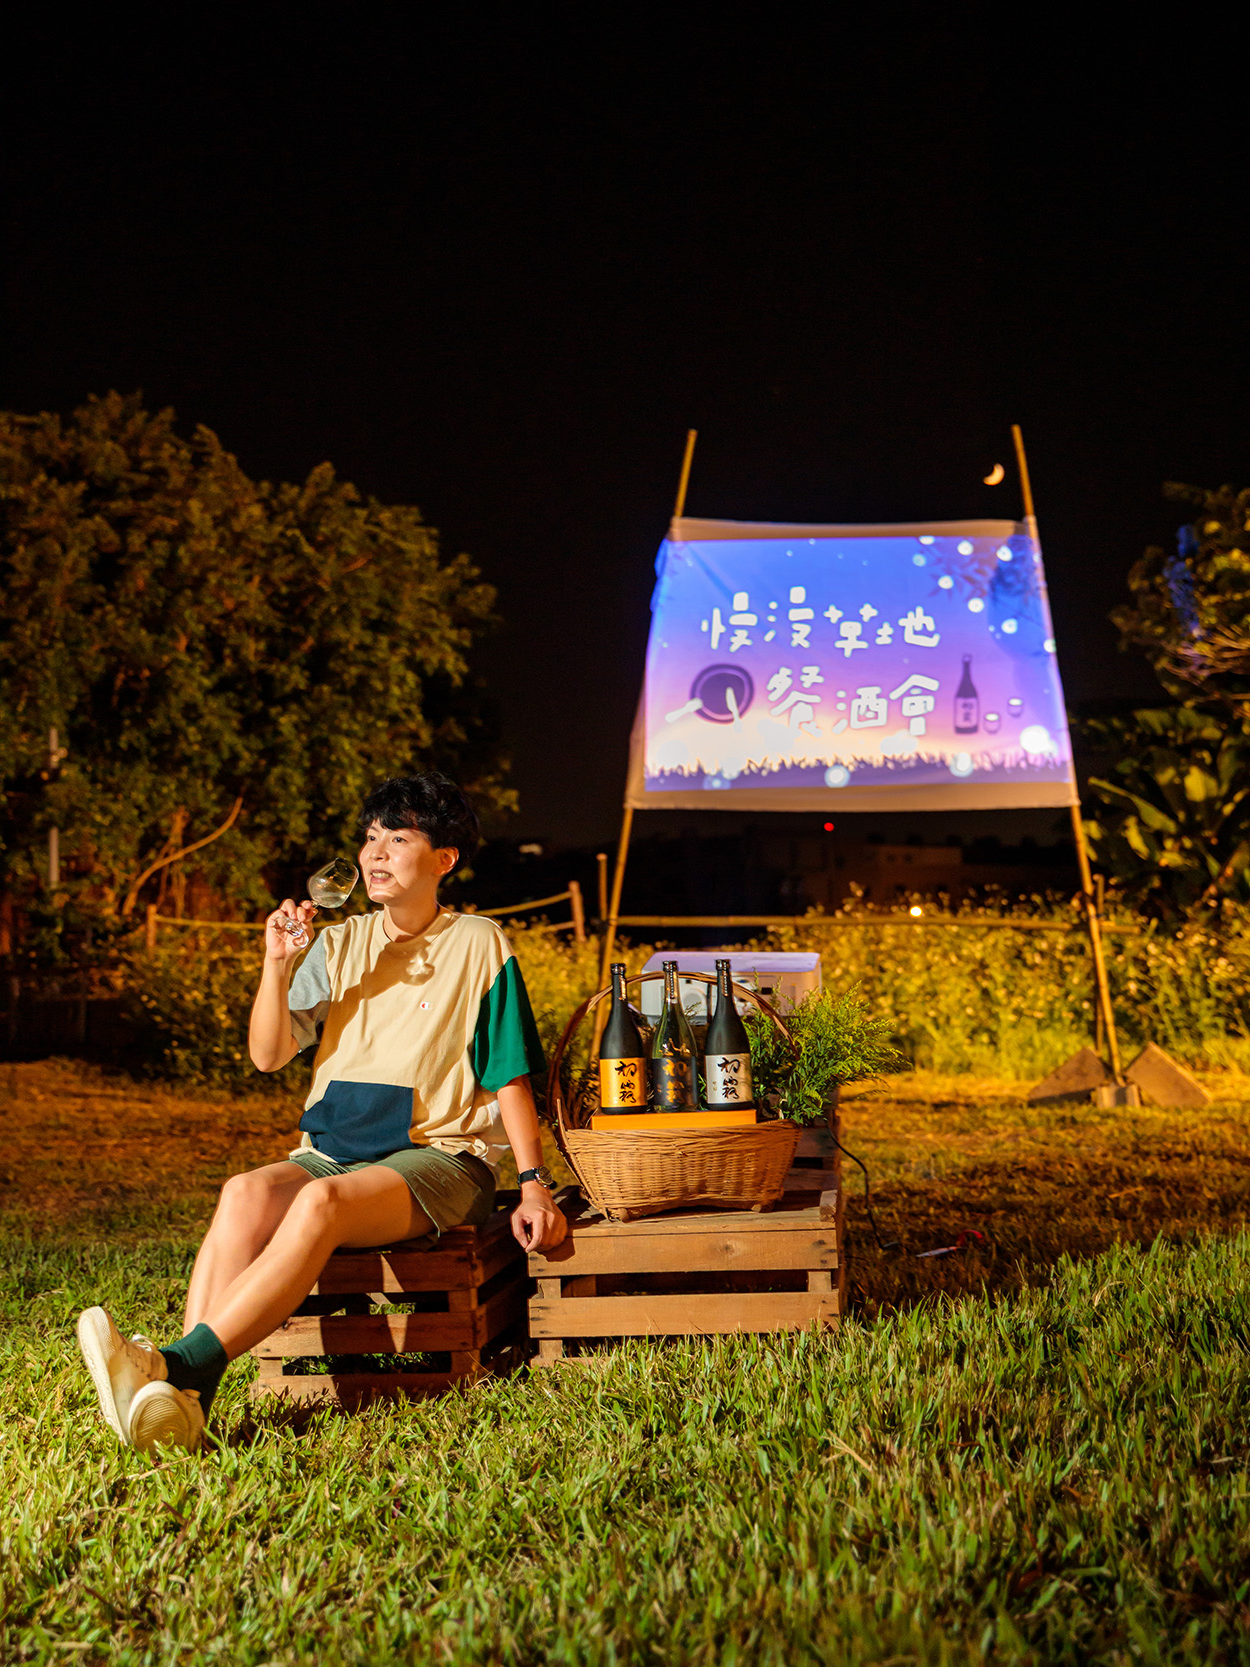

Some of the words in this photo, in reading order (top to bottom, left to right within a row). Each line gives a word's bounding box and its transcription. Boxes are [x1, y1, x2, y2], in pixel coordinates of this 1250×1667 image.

[701, 586, 940, 658] 慢漫草地
[766, 665, 940, 737] 餐酒會
